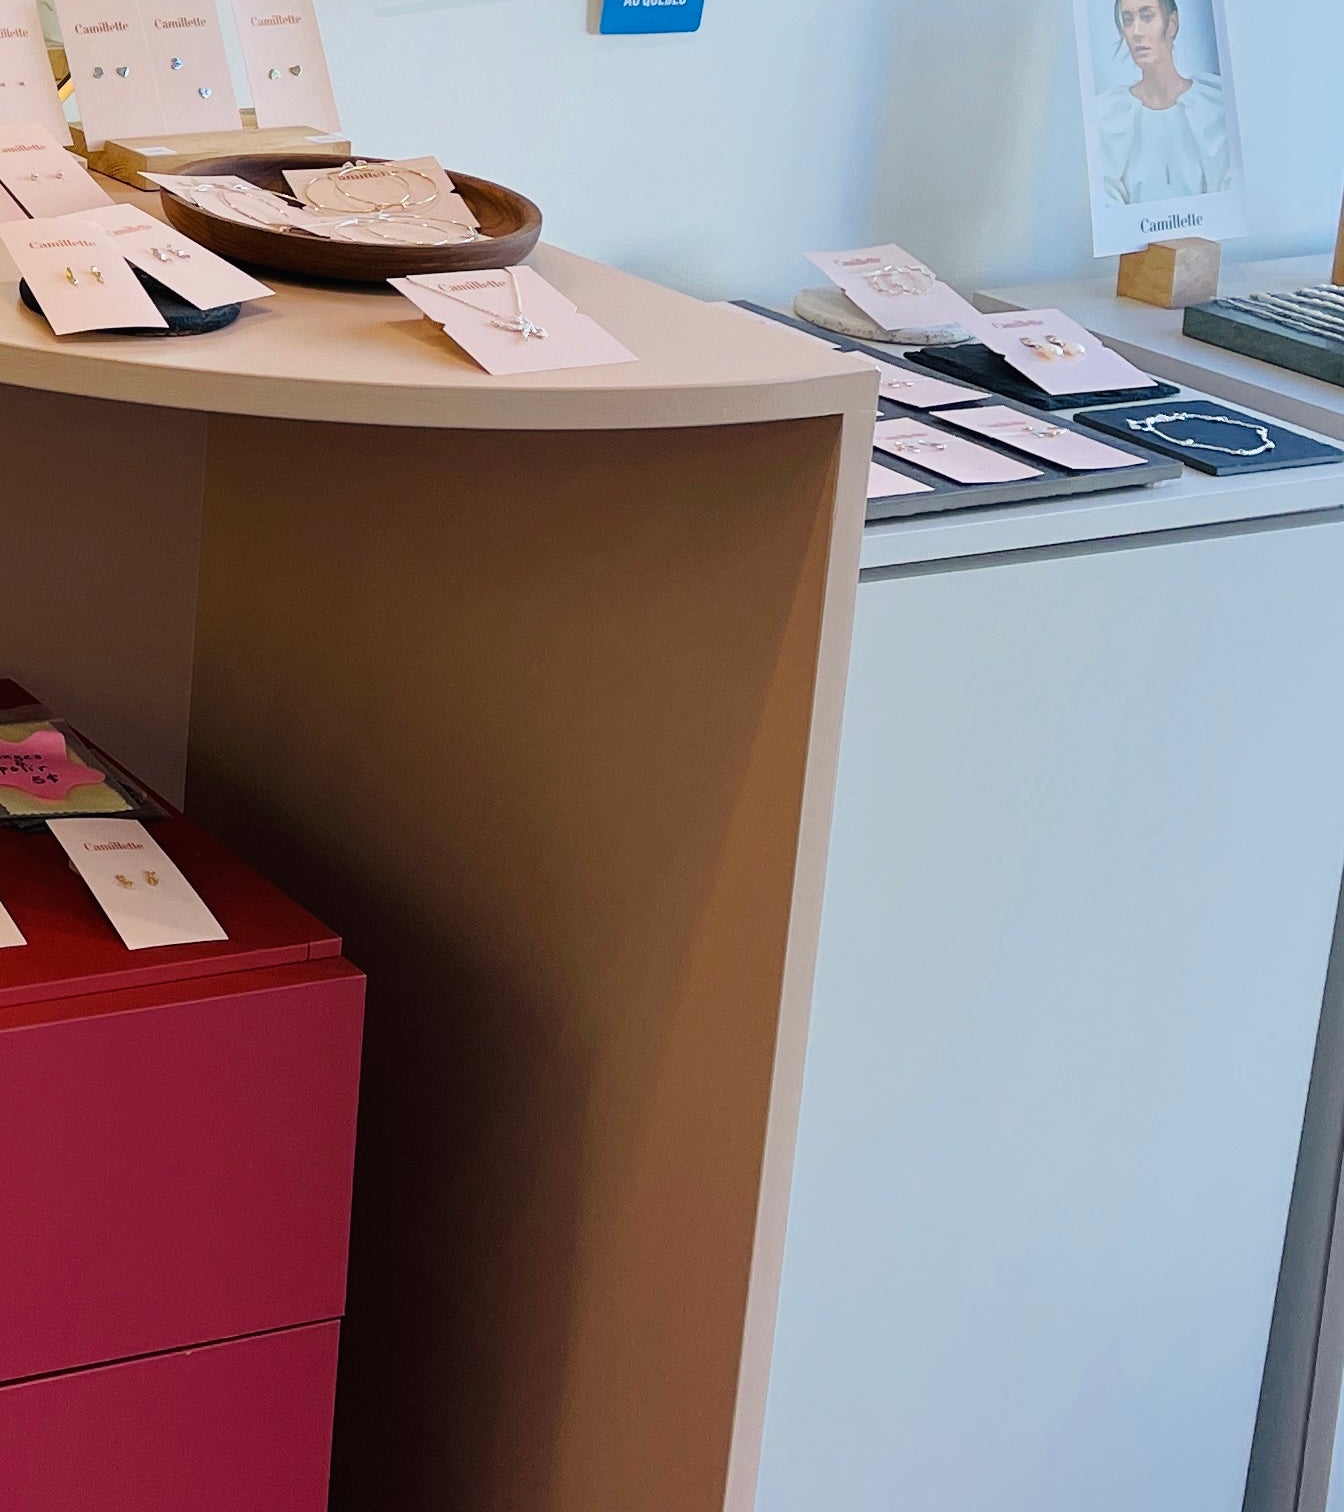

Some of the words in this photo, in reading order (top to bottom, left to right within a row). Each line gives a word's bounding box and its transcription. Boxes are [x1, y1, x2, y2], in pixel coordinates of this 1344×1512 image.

[154, 16, 207, 30] Camillette
[250, 14, 302, 27] Camillette
[74, 21, 130, 35] Camillette
[1140, 213, 1204, 233] Camillette
[28, 239, 97, 250] Camillette
[438, 279, 506, 292] Camillette
[83, 841, 144, 852] Camillette
